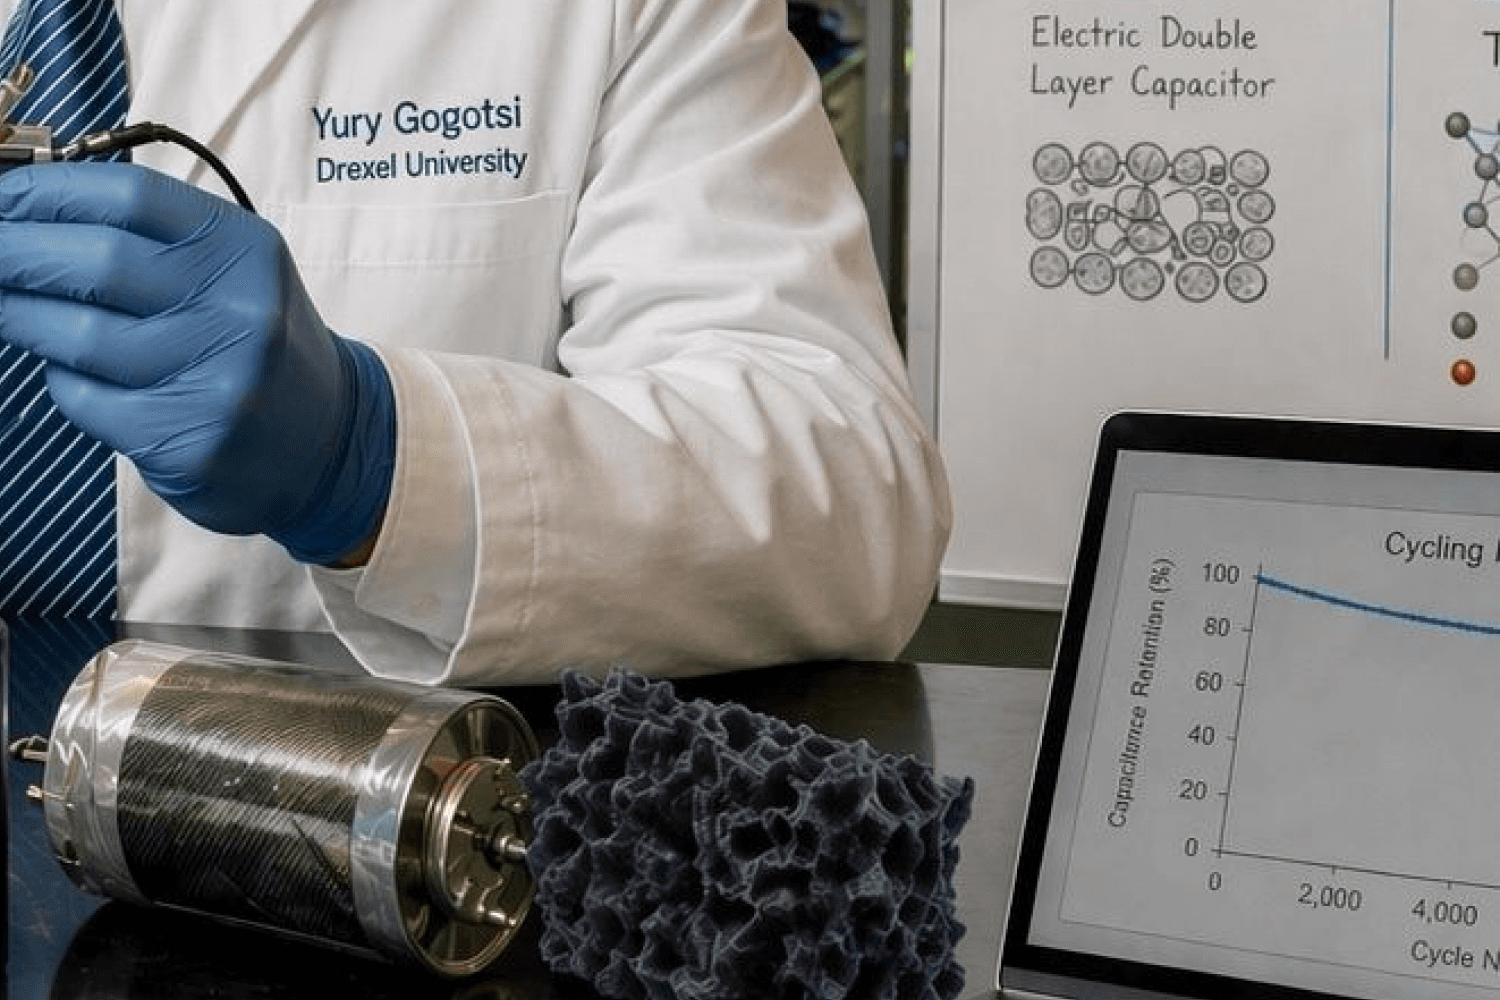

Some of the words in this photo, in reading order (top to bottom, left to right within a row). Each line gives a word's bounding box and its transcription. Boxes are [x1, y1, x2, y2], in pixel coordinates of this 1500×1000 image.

[1033, 15, 1140, 47] Electric
[1162, 15, 1257, 49] Double
[1031, 64, 1112, 108] Layer
[1131, 65, 1275, 110] Capacitor
[311, 107, 382, 146] Yury
[394, 96, 520, 140] Gogotsi
[318, 153, 396, 183] Drexel
[407, 148, 527, 178] University
[1386, 532, 1484, 568] Cycling
[1203, 563, 1239, 584] 100
[1203, 618, 1230, 636] 80
[1196, 671, 1223, 693] 60
[1189, 725, 1214, 745] 40
[1180, 779, 1207, 800] 20
[1185, 838, 1198, 856] 0
[1209, 872, 1221, 890] 0
[1298, 883, 1362, 911] 2,000
[1412, 899, 1477, 926] 4,000
[1412, 940, 1473, 967] Cycle
